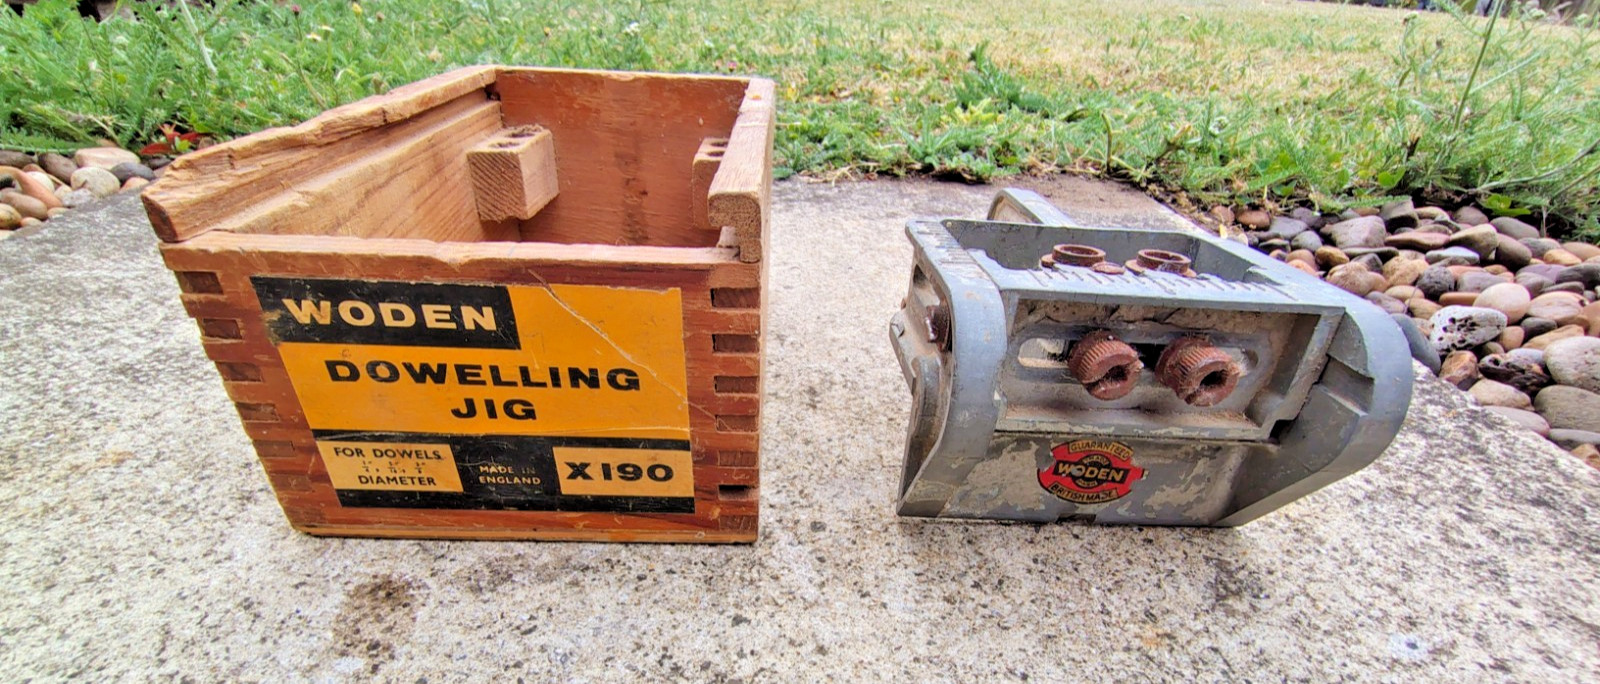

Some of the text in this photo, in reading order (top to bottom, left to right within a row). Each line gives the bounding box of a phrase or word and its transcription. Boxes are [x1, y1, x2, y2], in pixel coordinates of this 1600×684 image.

[282, 298, 497, 331] WODEN
[324, 359, 641, 391] DOWELLING
[451, 398, 537, 420] JIG
[333, 447, 442, 460] FOR DOWELS
[479, 465, 514, 474] MADE
[564, 461, 674, 482] X190
[1058, 462, 1124, 482] WODEN
[358, 475, 437, 486] DIAMETER
[479, 475, 542, 485] ENGLAND
[1050, 483, 1085, 501] BRITISH
